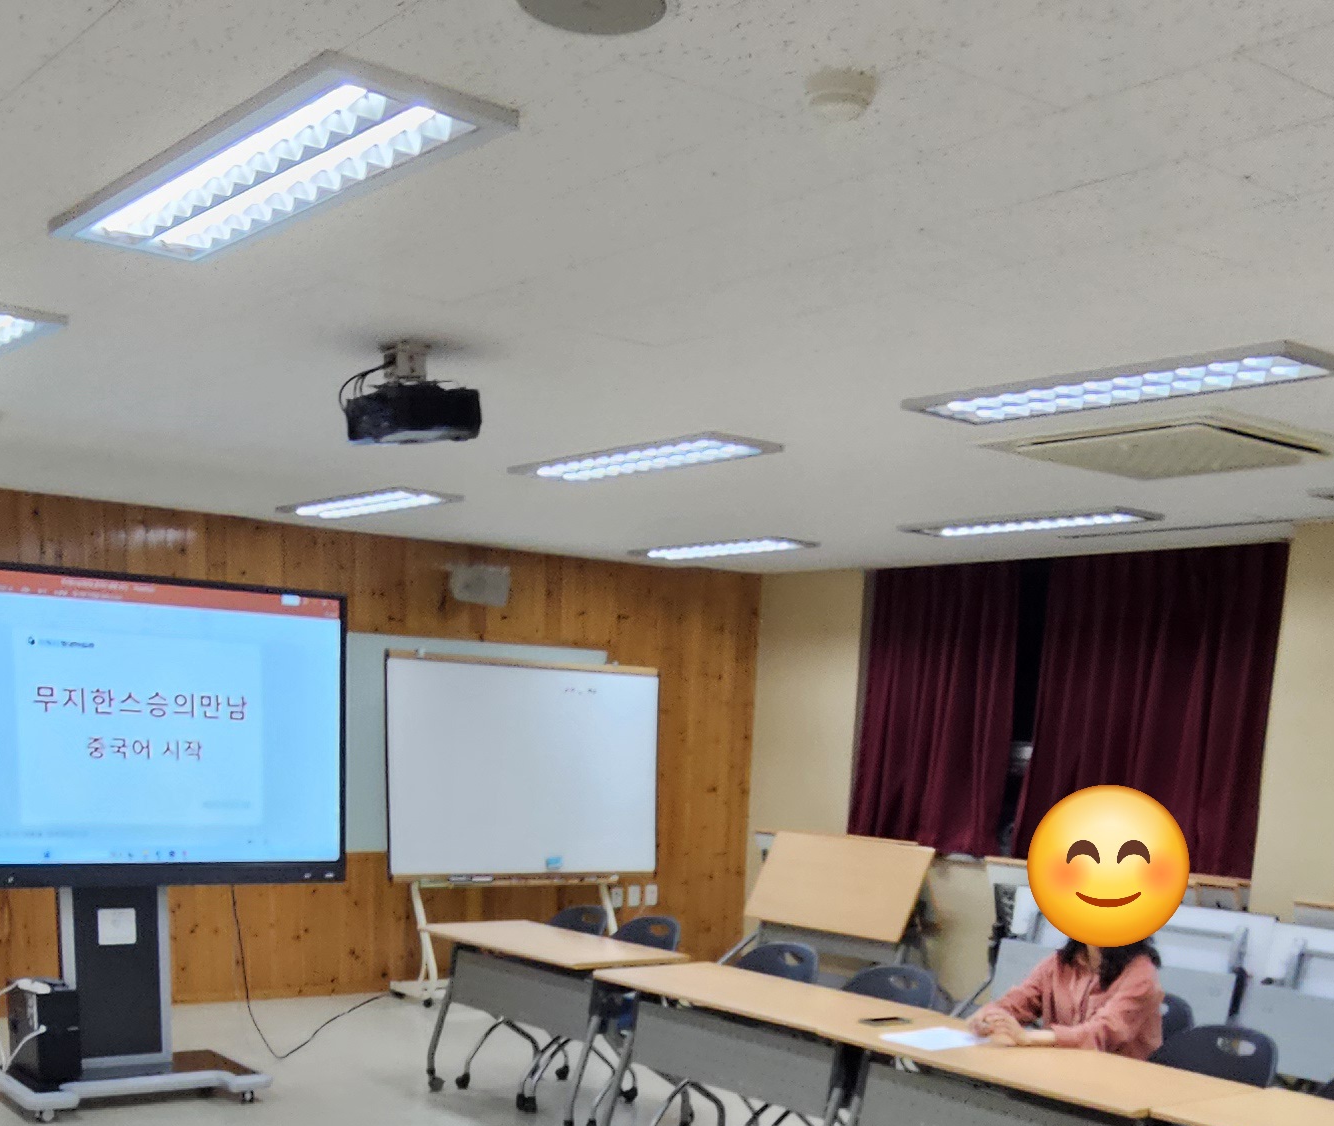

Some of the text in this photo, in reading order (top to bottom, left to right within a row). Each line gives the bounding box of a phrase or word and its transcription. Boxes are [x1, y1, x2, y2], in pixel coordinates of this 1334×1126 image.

[33, 686, 248, 721] 무지한스승의만남
[87, 736, 203, 761] 중국어 시작
